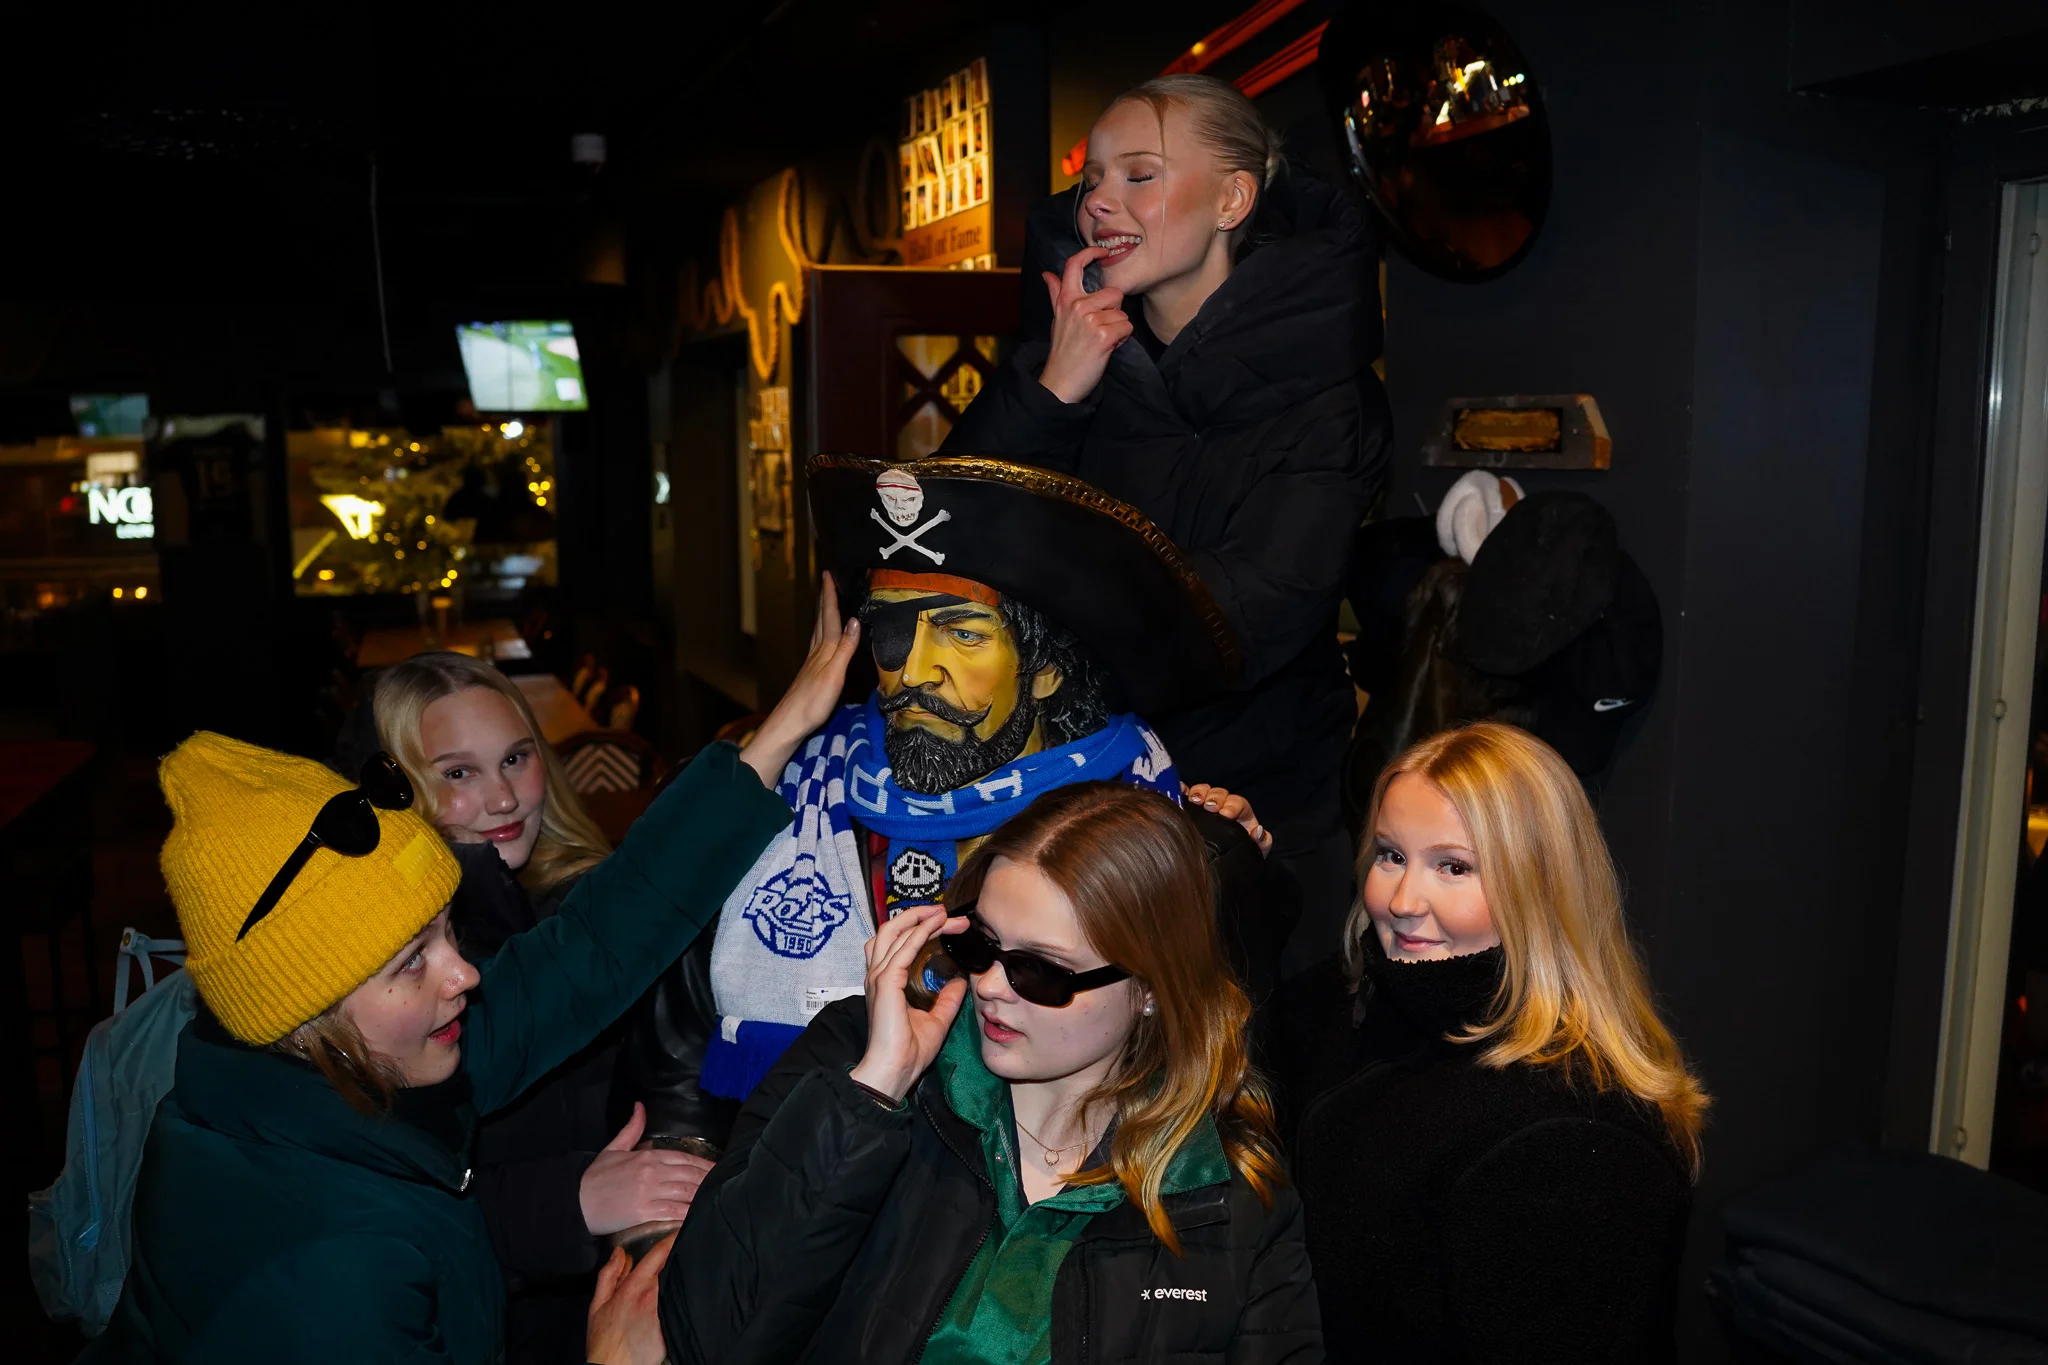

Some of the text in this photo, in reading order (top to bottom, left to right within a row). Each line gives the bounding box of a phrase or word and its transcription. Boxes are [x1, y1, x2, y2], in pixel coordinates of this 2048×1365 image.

[951, 225, 981, 252] Fame
[784, 935, 812, 951] 1950
[1154, 1288, 1207, 1302] everest
